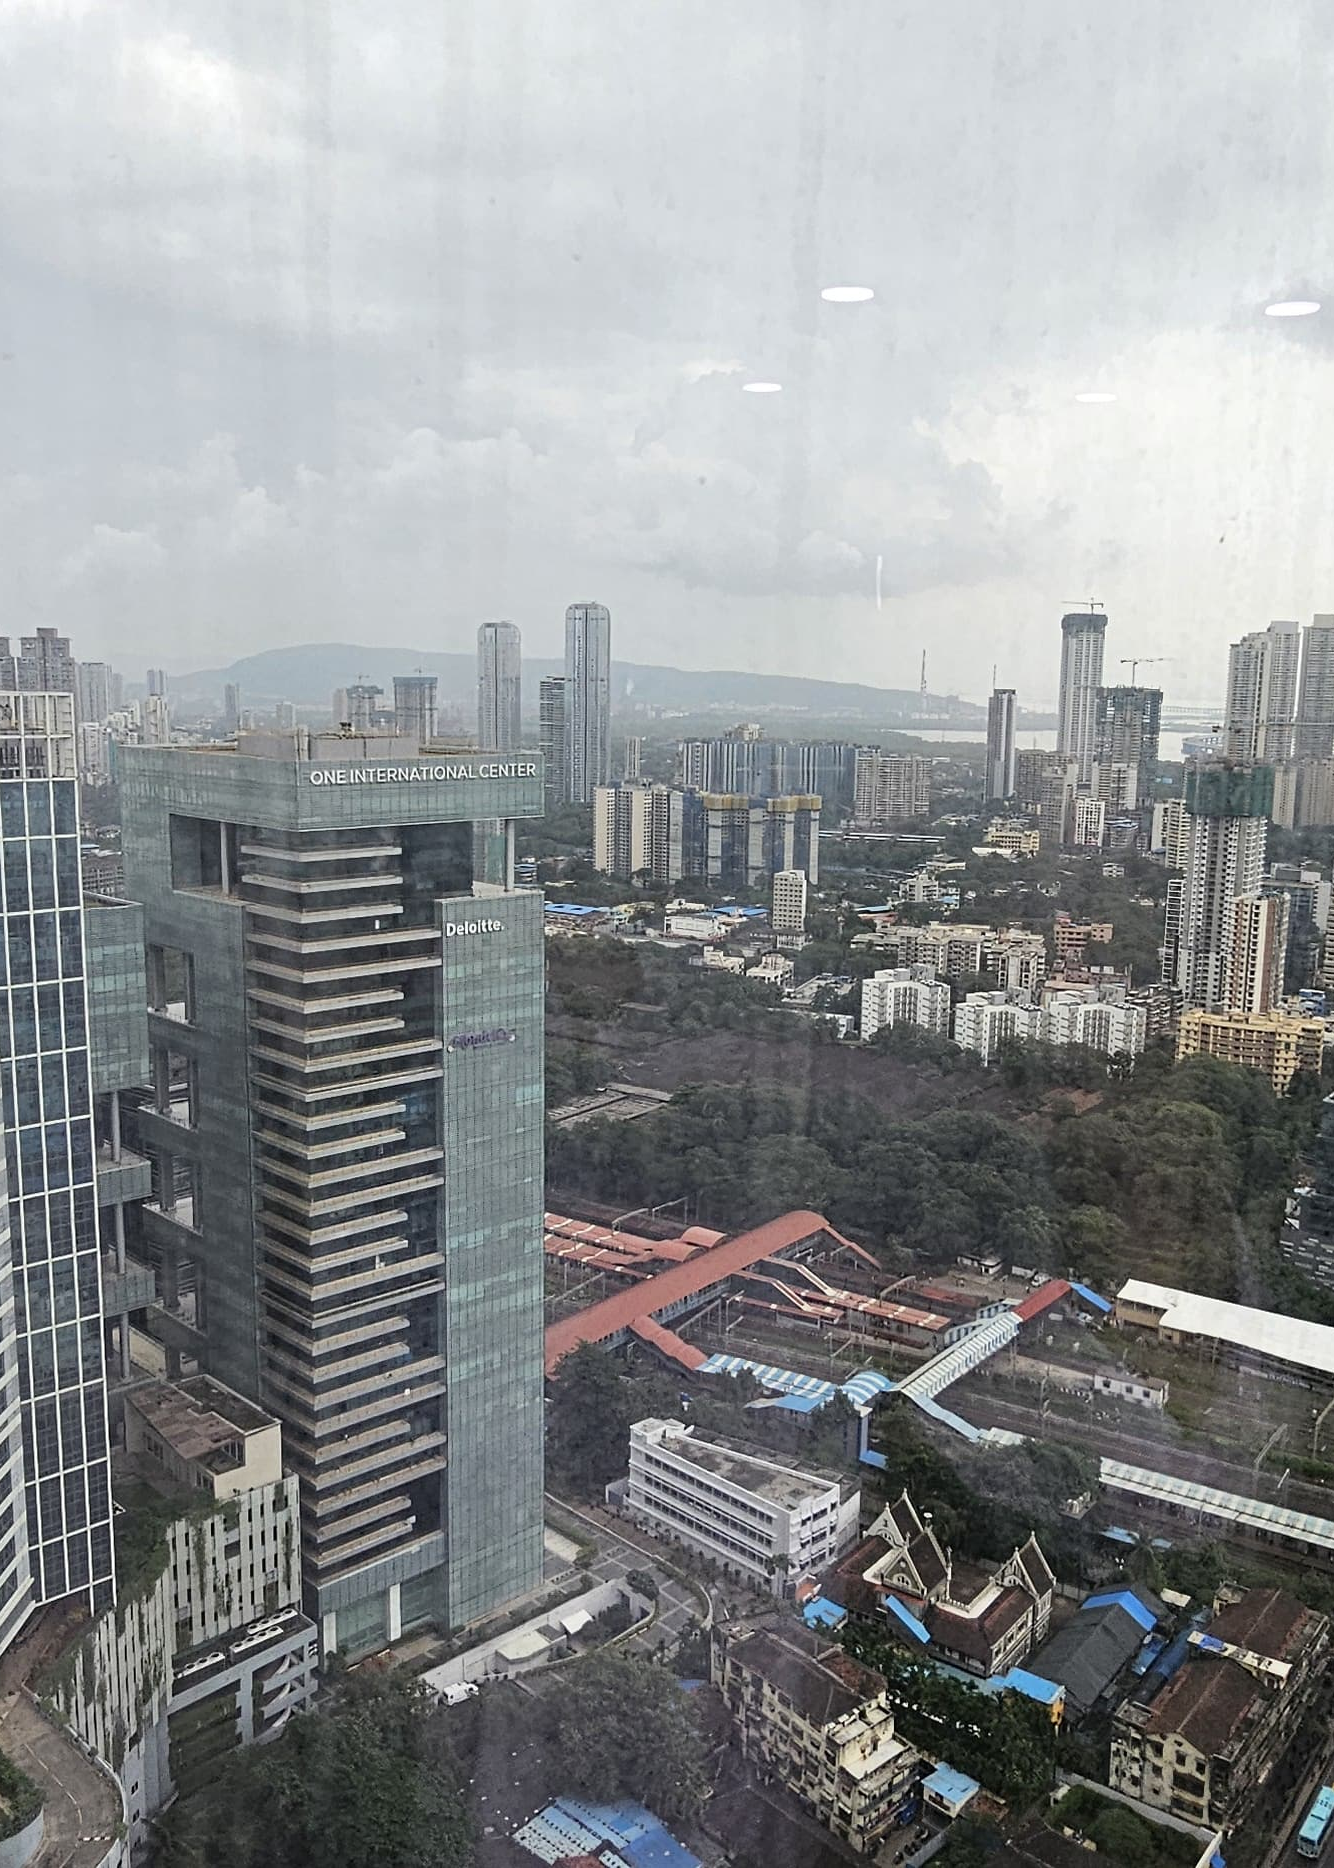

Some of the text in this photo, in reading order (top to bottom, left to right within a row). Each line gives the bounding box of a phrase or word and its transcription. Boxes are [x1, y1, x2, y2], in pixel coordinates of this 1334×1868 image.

[310, 763, 536, 785] ONE INTERNATIONAL CENTER
[446, 918, 505, 937] Deloitte.
